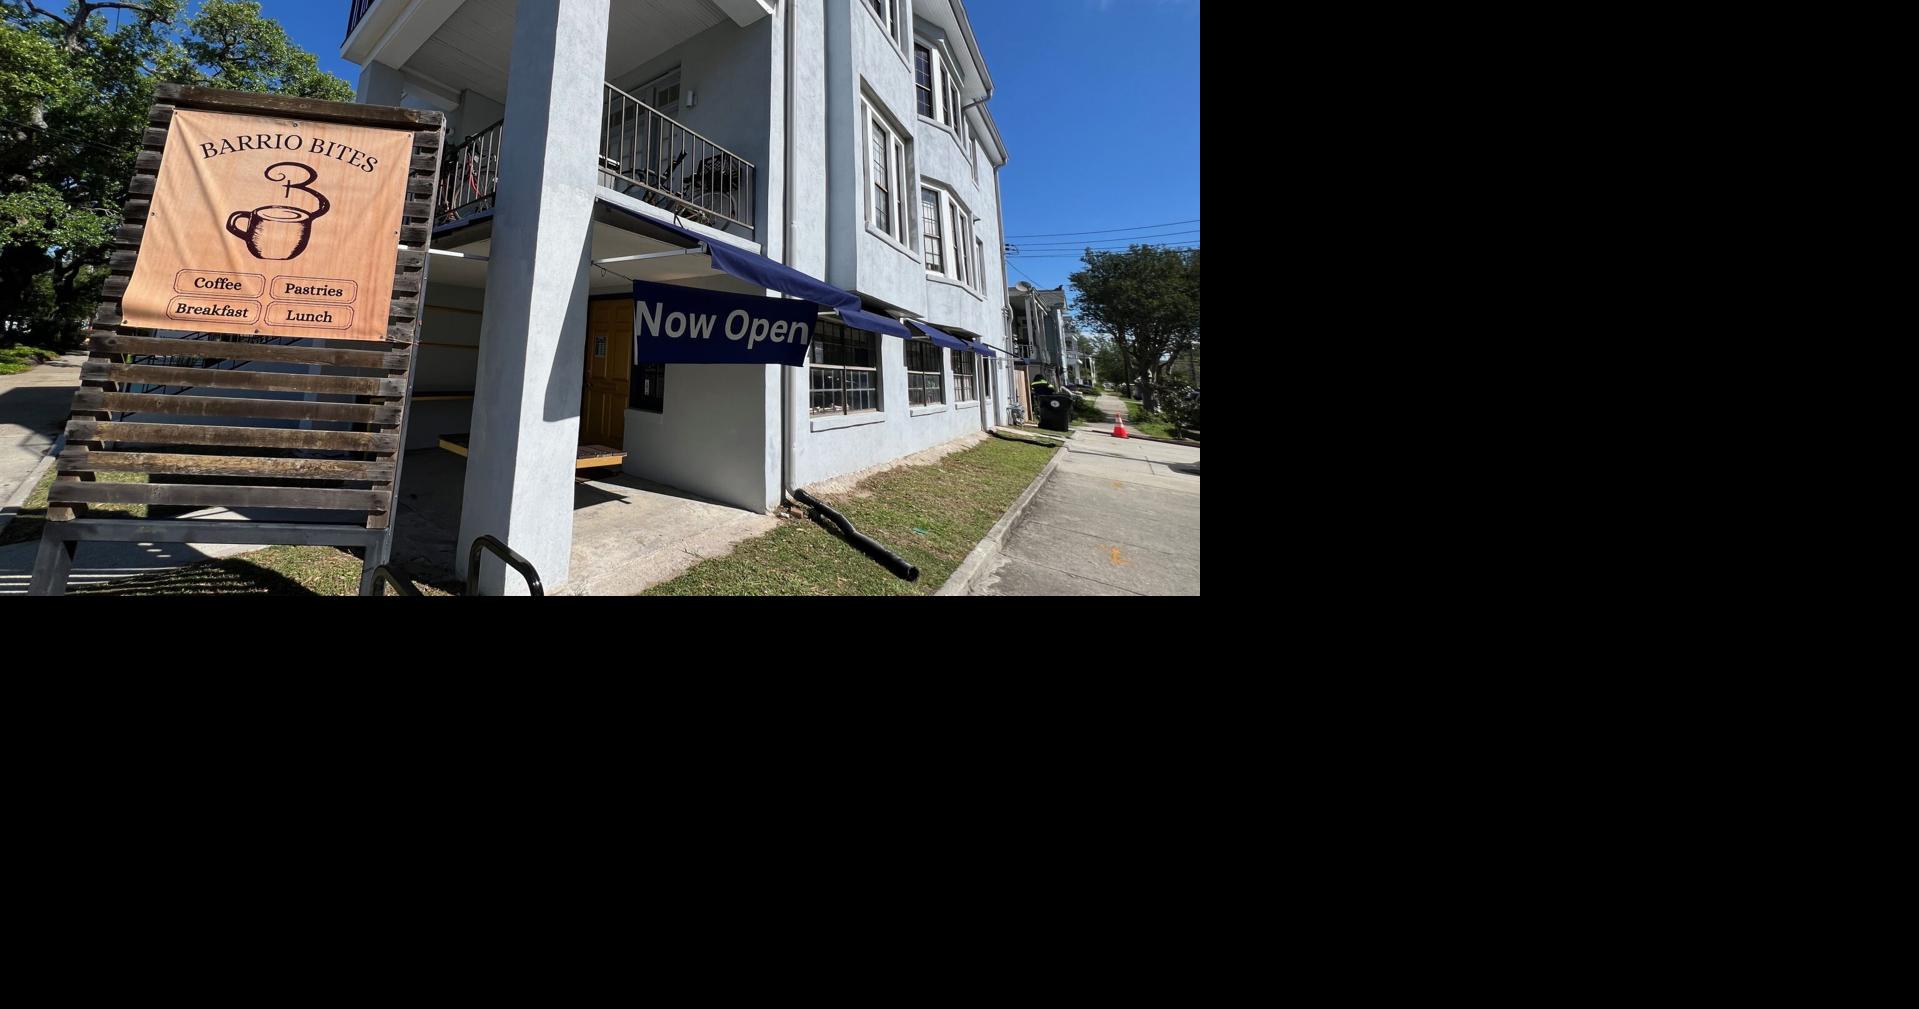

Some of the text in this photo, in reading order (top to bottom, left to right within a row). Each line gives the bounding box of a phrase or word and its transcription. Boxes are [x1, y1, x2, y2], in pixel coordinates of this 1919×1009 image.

[200, 133, 379, 173] BARRIO BITES
[193, 277, 242, 291] Coffee
[284, 283, 343, 298] Pastries
[175, 302, 249, 319] Breakfast
[286, 310, 333, 323] Lunch
[636, 300, 809, 350] Now Open
